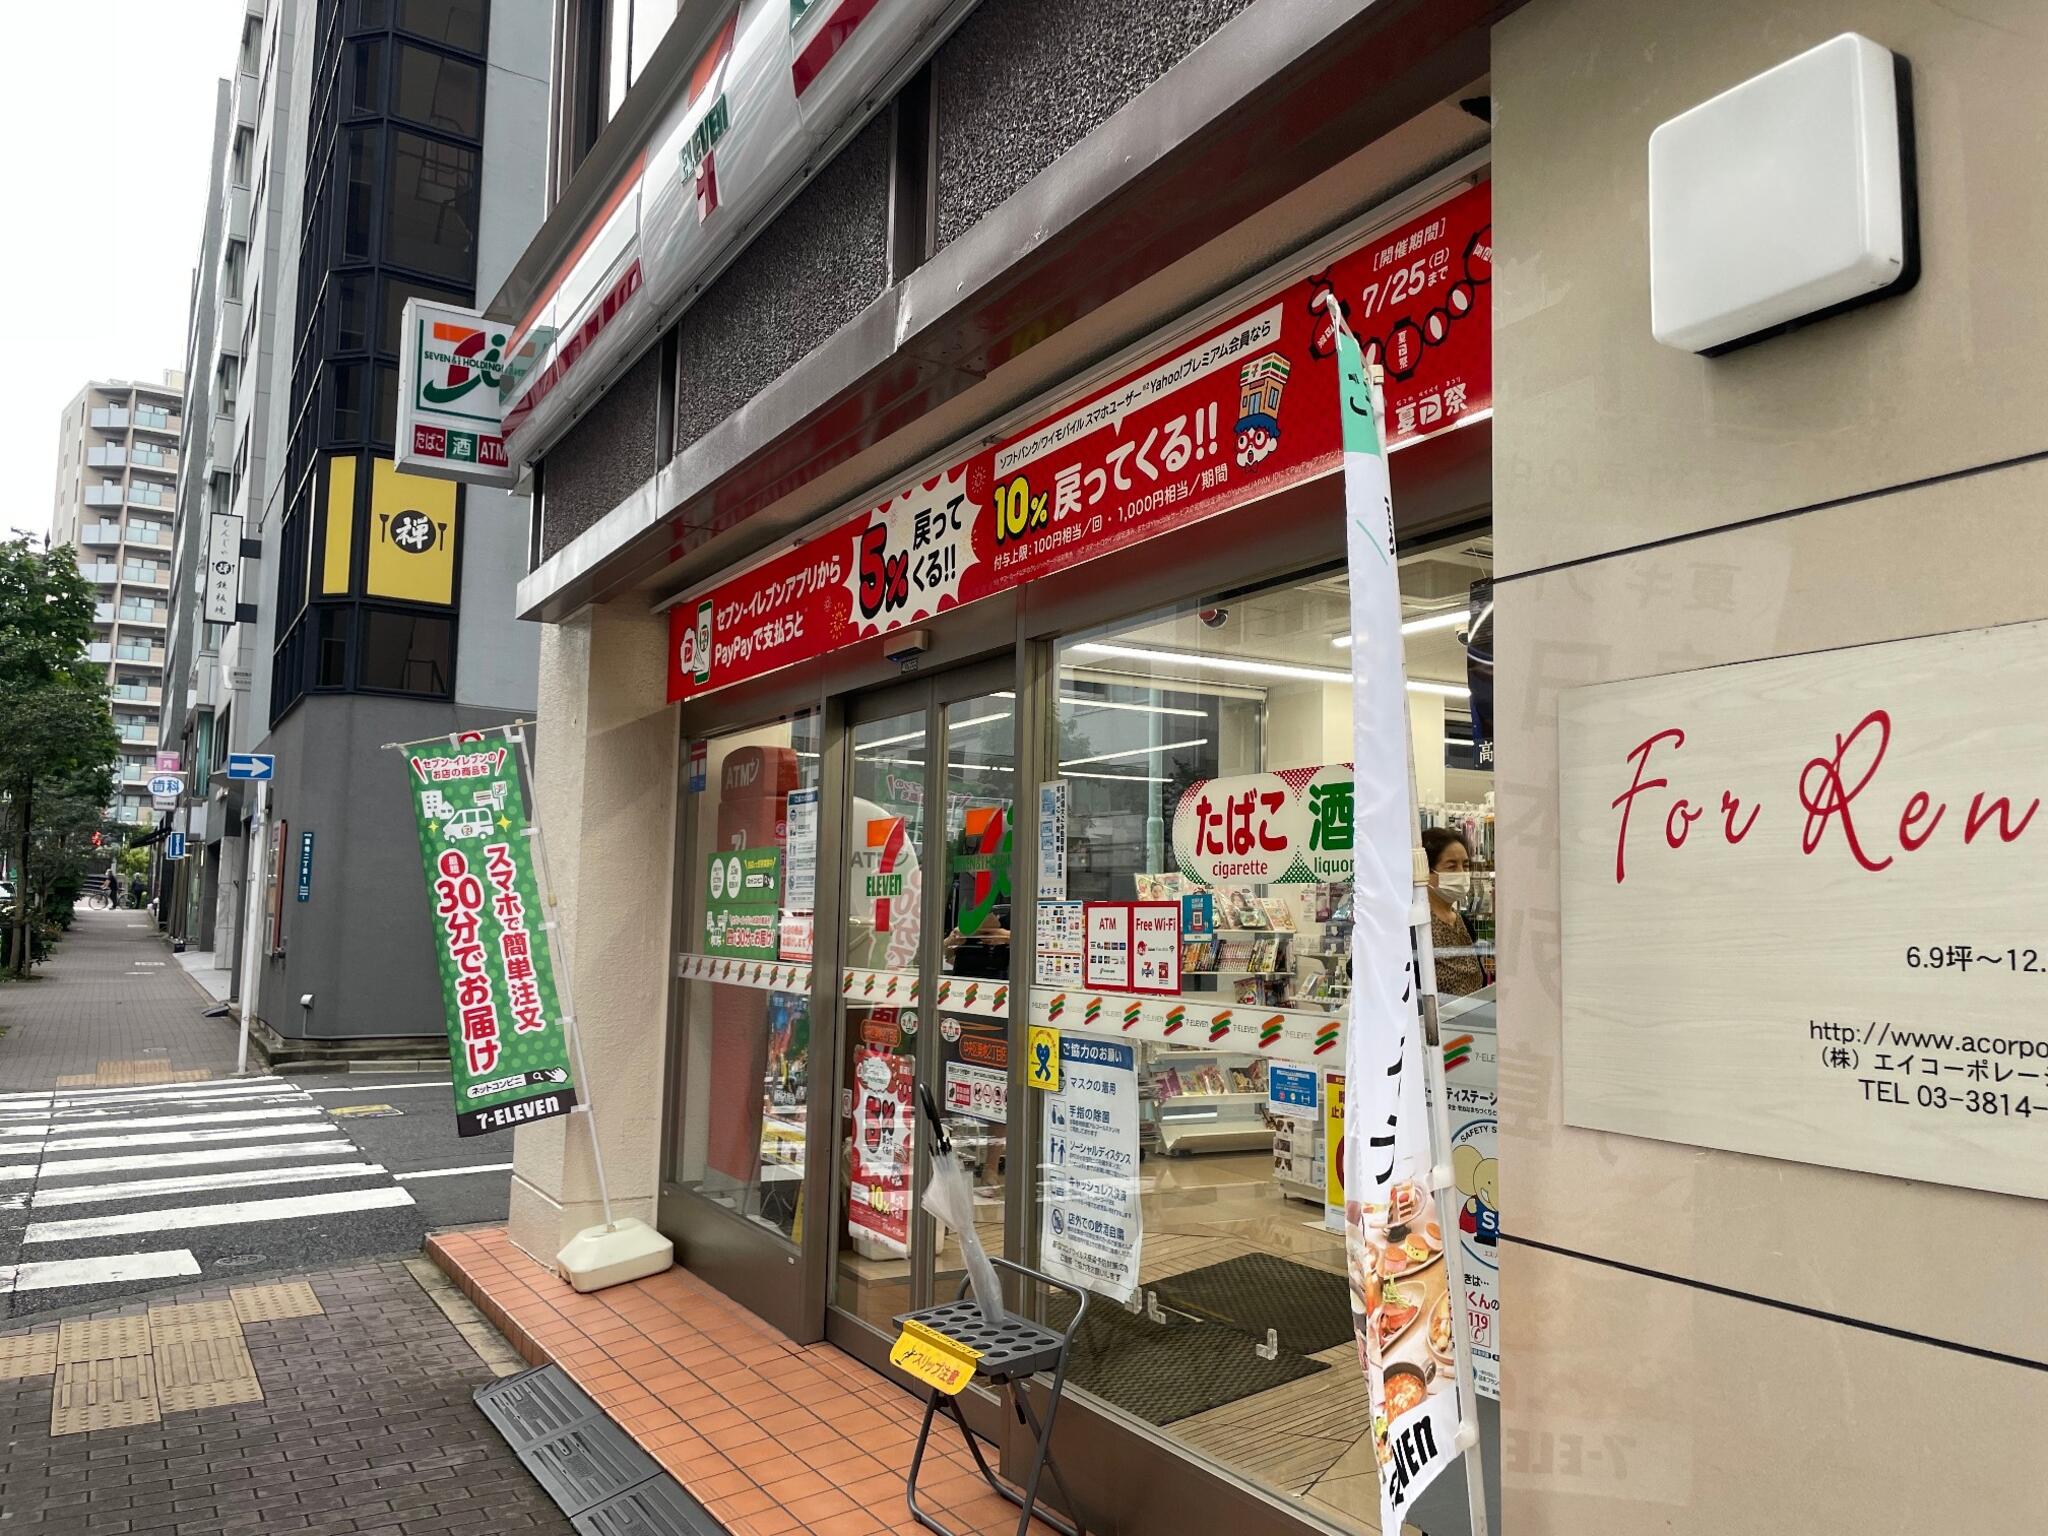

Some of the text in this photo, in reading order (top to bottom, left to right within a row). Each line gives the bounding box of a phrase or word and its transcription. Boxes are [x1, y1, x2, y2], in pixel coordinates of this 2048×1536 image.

[1363, 248, 1450, 318] 7/25 (日) まで
[1085, 387, 1142, 424] スマホユーザー
[1150, 320, 1272, 394] Yahoo!プレミアム会員なら
[415, 431, 445, 452] たばこ
[452, 436, 471, 457] 酒
[480, 441, 508, 462] ATM
[993, 401, 1218, 546] 10% 戻ってくる!!
[395, 516, 429, 550] 禅
[913, 494, 965, 550] 戻って
[859, 522, 909, 620] 5%
[912, 544, 957, 592] くる!!
[714, 613, 804, 668] PayPayで支払うと
[152, 779, 180, 793] 歯科
[432, 765, 490, 780] お店の商品を
[725, 763, 751, 790] ATM
[1308, 781, 1355, 851] 酒
[1612, 728, 1761, 884] For
[1196, 787, 1288, 857] たばこ
[1212, 861, 1268, 879] cigarette
[1099, 917, 1117, 931] ATM
[1135, 917, 1177, 932] Free Wi-Fi
[484, 845, 545, 1031] スマホで簡単注文
[437, 877, 499, 1073] 30分でお届け
[1062, 1042, 1123, 1064] ご協力のお願い
[471, 1077, 524, 1096] ネットコンビニ
[1070, 1076, 1117, 1096] マスクの着用
[1858, 1078, 1909, 1106] TEL
[1069, 1104, 1111, 1125] 手指の除菌
[1460, 1125, 1489, 1143] SAFETY
[1069, 1141, 1132, 1166] ソーシャルディスタンス
